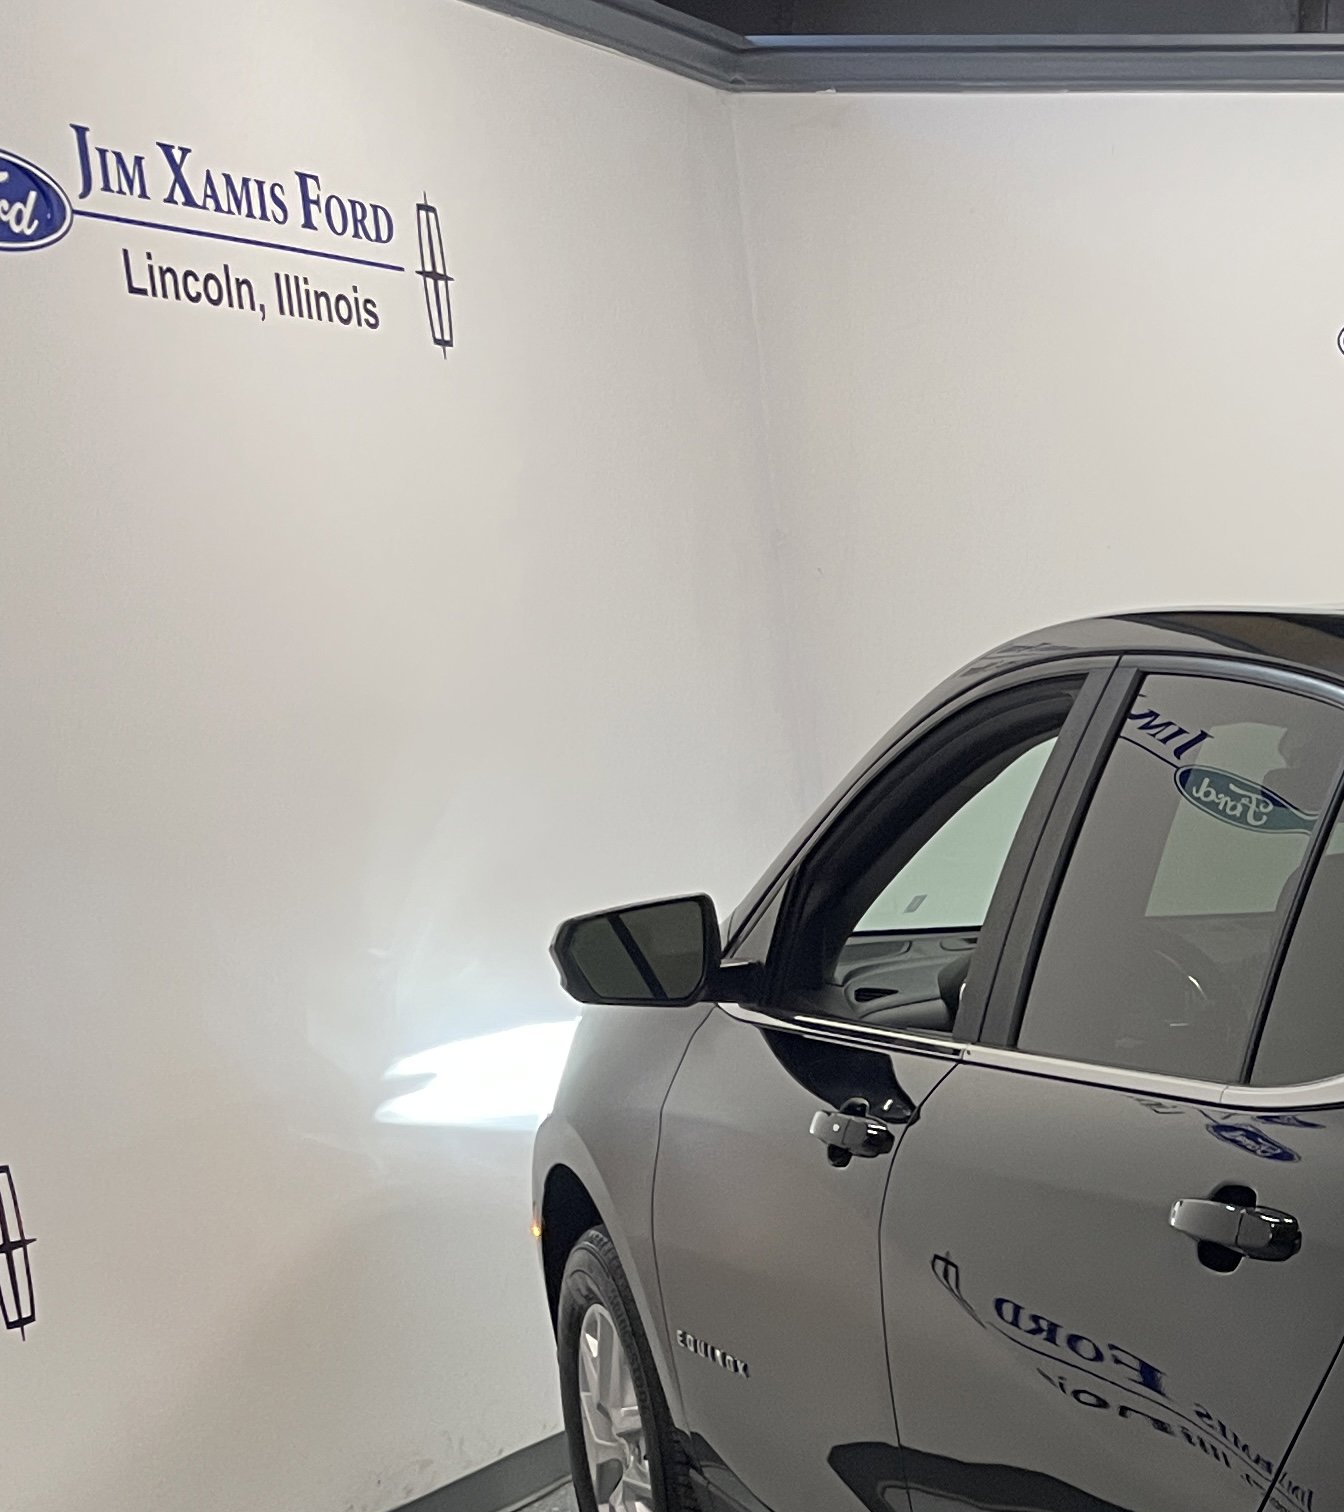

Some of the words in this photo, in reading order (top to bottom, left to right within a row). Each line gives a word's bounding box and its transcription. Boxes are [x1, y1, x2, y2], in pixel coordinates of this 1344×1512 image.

[69, 123, 151, 200] JIM
[156, 141, 289, 225] XAMIS
[294, 170, 394, 244] FORD
[122, 248, 267, 321] Lincoln,
[274, 271, 380, 329] Illinois
